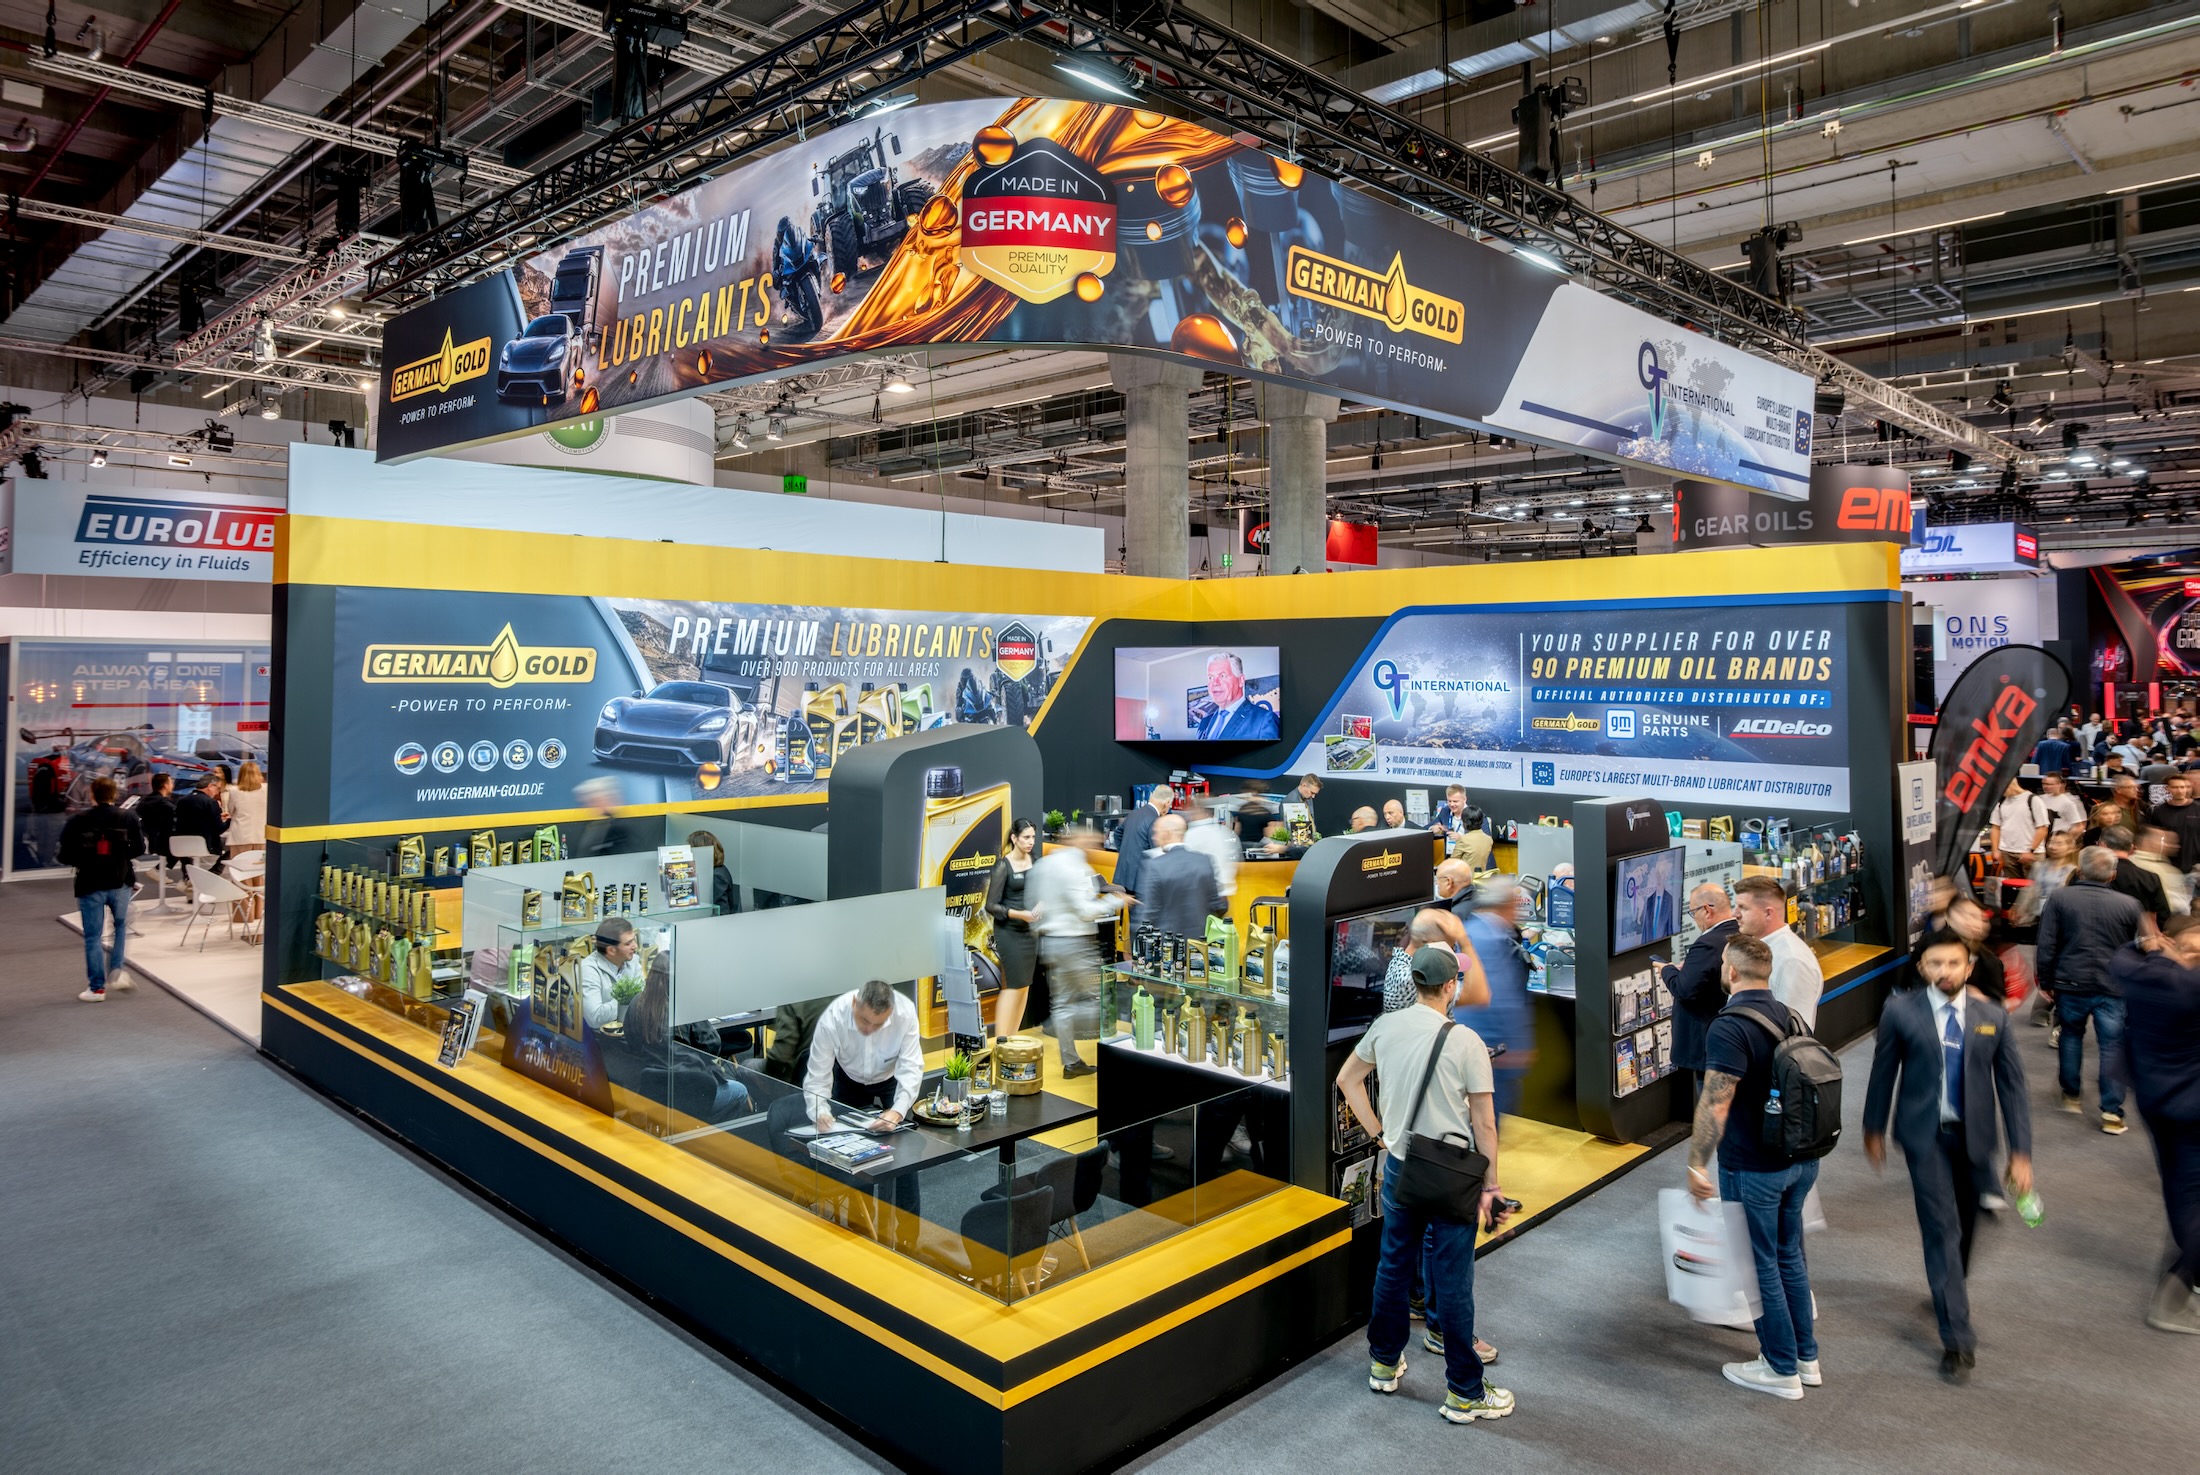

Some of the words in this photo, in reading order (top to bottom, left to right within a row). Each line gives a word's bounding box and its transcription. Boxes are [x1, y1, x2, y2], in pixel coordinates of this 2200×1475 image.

[1001, 177, 1056, 192] MADE
[1061, 180, 1079, 194] IN
[968, 210, 1112, 236] GERMANY
[618, 209, 751, 303] PREMIUM
[1009, 251, 1068, 264] PREMIUM
[1009, 263, 1066, 275] QUALITY
[1294, 258, 1386, 311] GERMAN
[1412, 298, 1459, 333] GOLD
[599, 273, 774, 370] LUBRICANTS
[1368, 338, 1384, 355] TO
[394, 362, 440, 395] GERMAN
[454, 345, 488, 374] GOLD
[1668, 383, 1735, 417] INTERNATIONAL
[427, 404, 437, 419] TO
[1775, 403, 1792, 419] LARGEST
[1744, 425, 1766, 443] LUBRICANT
[1766, 432, 1790, 450] DISTRIBUTOR
[558, 445, 594, 454] AUTOMOTIVE
[1695, 514, 1749, 537] GEAR
[1755, 511, 1813, 531] OILS
[78, 550, 171, 570] Efficiency
[177, 554, 192, 568] in
[198, 555, 250, 571] Fluids
[1946, 615, 2009, 635] ONS
[668, 616, 820, 657] PREMIUM
[830, 622, 993, 659] LUBRICANTS
[1532, 633, 1582, 652] YOUR
[1593, 632, 1700, 651] SUPPLIER
[1712, 631, 1755, 650] FOR
[1769, 630, 1832, 651] OVER
[1952, 636, 2009, 648] MOTION
[999, 647, 1034, 656] GERMANY
[72, 665, 169, 677] ALWAYS
[176, 665, 221, 677] ONE
[372, 653, 490, 676] GERMAN
[525, 655, 588, 676] GOLD
[740, 660, 772, 677] OVER
[774, 660, 798, 677] 900
[803, 660, 859, 678] PRODUCTS
[863, 661, 884, 677] FOR
[886, 661, 905, 677] ALL
[908, 661, 940, 678] AREAS
[1531, 657, 1557, 679] 90
[1565, 657, 1672, 680] PREMIUM
[1679, 657, 1717, 680] OIL
[1727, 657, 1832, 681] BRANDS
[72, 680, 131, 690] STEP
[136, 680, 214, 690] AHEAD
[1411, 680, 1511, 692] INTERNATIONAL
[466, 699, 486, 711] TO
[1536, 690, 1593, 701] OFFICIAL
[1601, 690, 1684, 702] AUTHORIZED
[1692, 691, 1791, 704] DISTRIBUTOR
[1799, 693, 1826, 706] OF:
[1533, 719, 1567, 729] GERMAN
[1577, 720, 1599, 730] GOLD
[1611, 716, 1631, 731] gm
[1642, 714, 1710, 727] GENUINE
[1733, 720, 1833, 736] ACDelco
[1642, 726, 1689, 737] PARTS
[1416, 756, 1423, 765] OF
[1424, 756, 1454, 767] WAREHOUSE
[1457, 759, 1467, 767] ALL
[1468, 759, 1488, 768] BRANDS
[1496, 762, 1513, 770] STOCK
[1538, 770, 1548, 778] EU
[1560, 769, 1601, 783] EUROPE'S
[1602, 771, 1641, 786] LARGEST
[1642, 774, 1705, 788] MULTI-BRAND
[1707, 778, 1763, 792] LUBRICANT
[1765, 780, 1832, 797] DISTRIBUTOR
[416, 783, 545, 802] WWW.GERMAN-GOLD.DE
[951, 859, 975, 870] GERMAN
[981, 857, 994, 865] GOLD
[1363, 858, 1384, 869] GERMAN
[1389, 856, 1400, 865] GOLD
[963, 892, 983, 906] POWER
